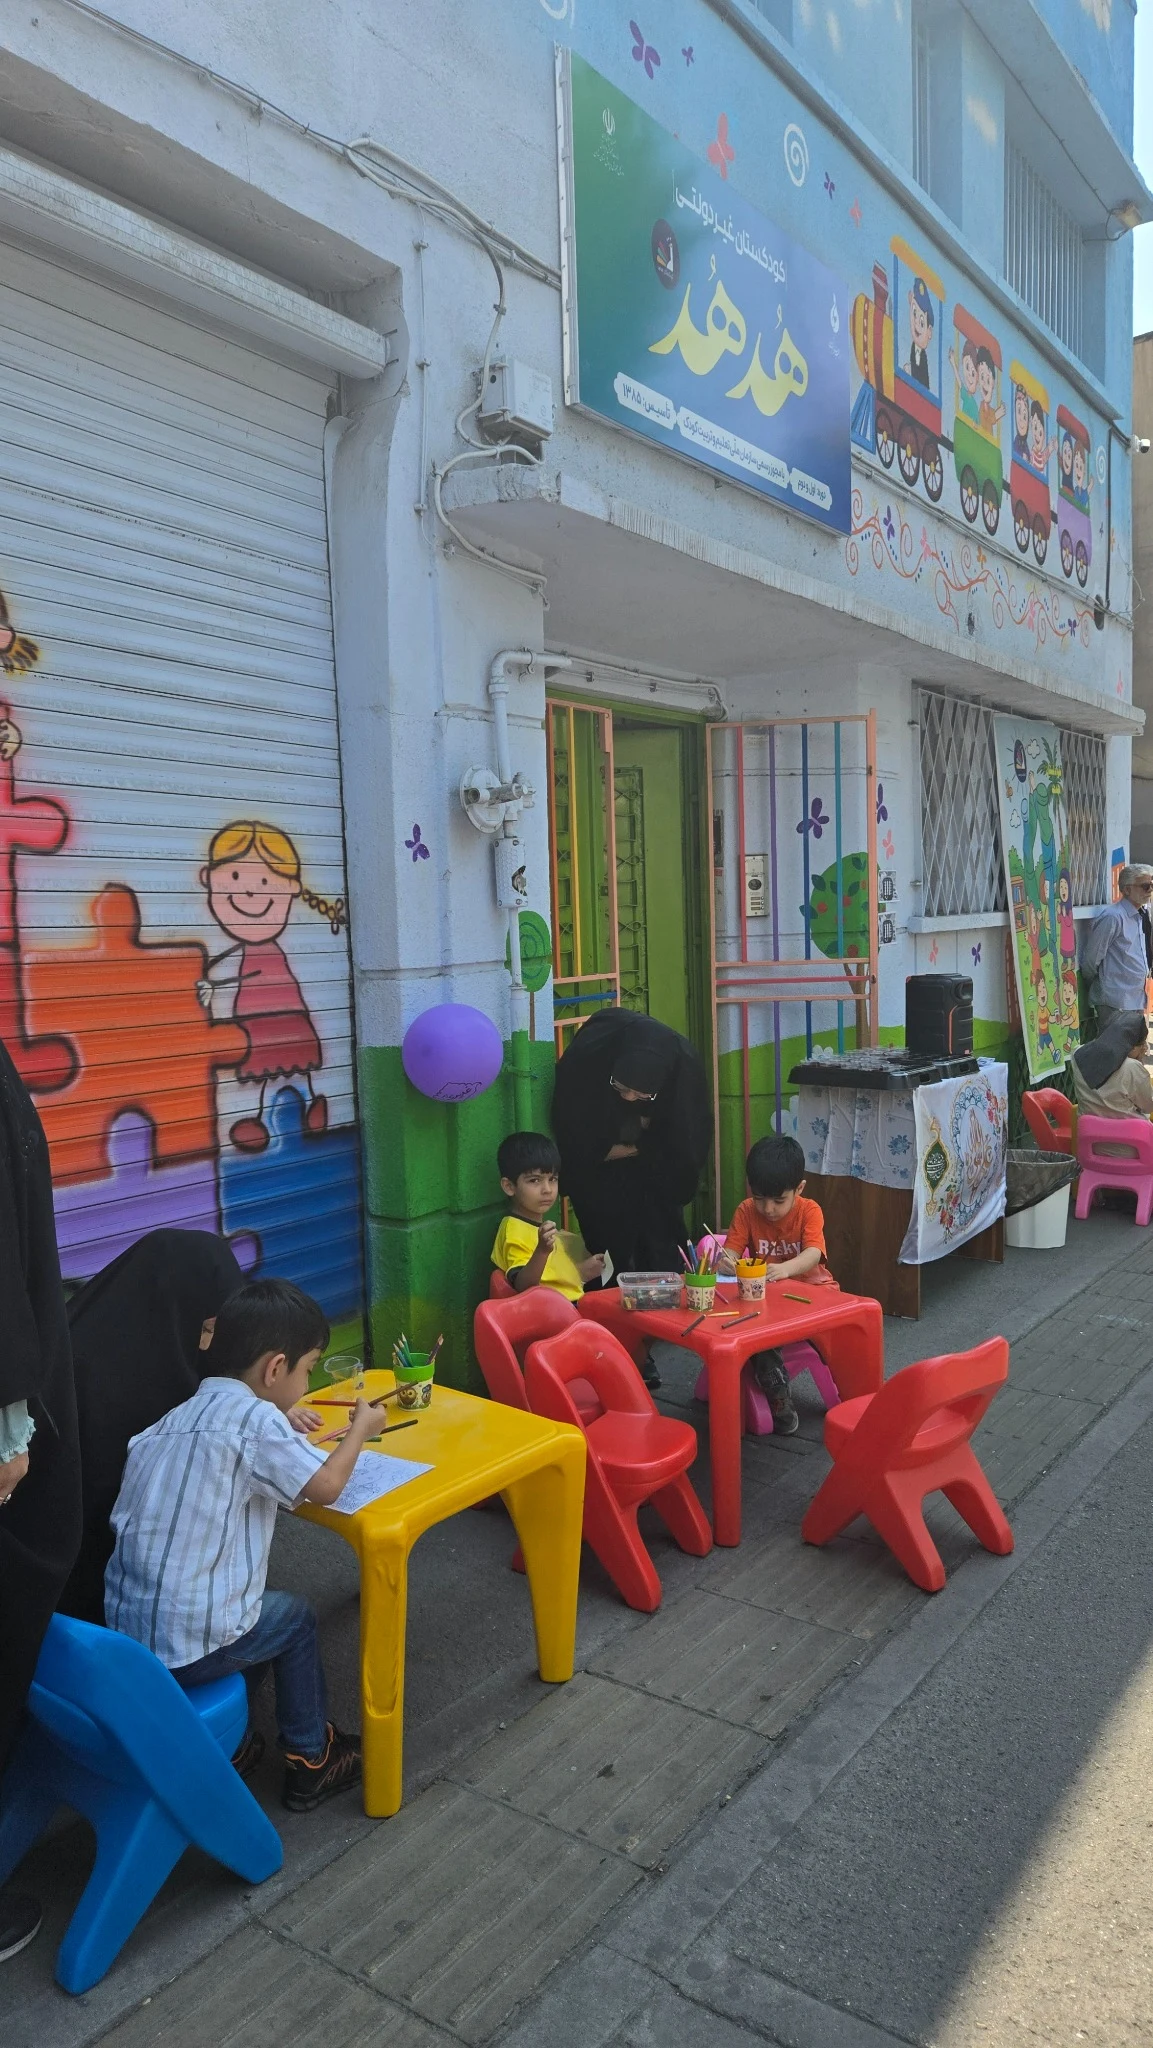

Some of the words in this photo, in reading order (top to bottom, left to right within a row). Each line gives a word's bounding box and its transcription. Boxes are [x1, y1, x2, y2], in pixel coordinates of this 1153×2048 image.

[735, 229, 786, 283] کودکستان
[622, 382, 642, 405] ۱۳۸۵
[758, 1238, 801, 1257] Risky
